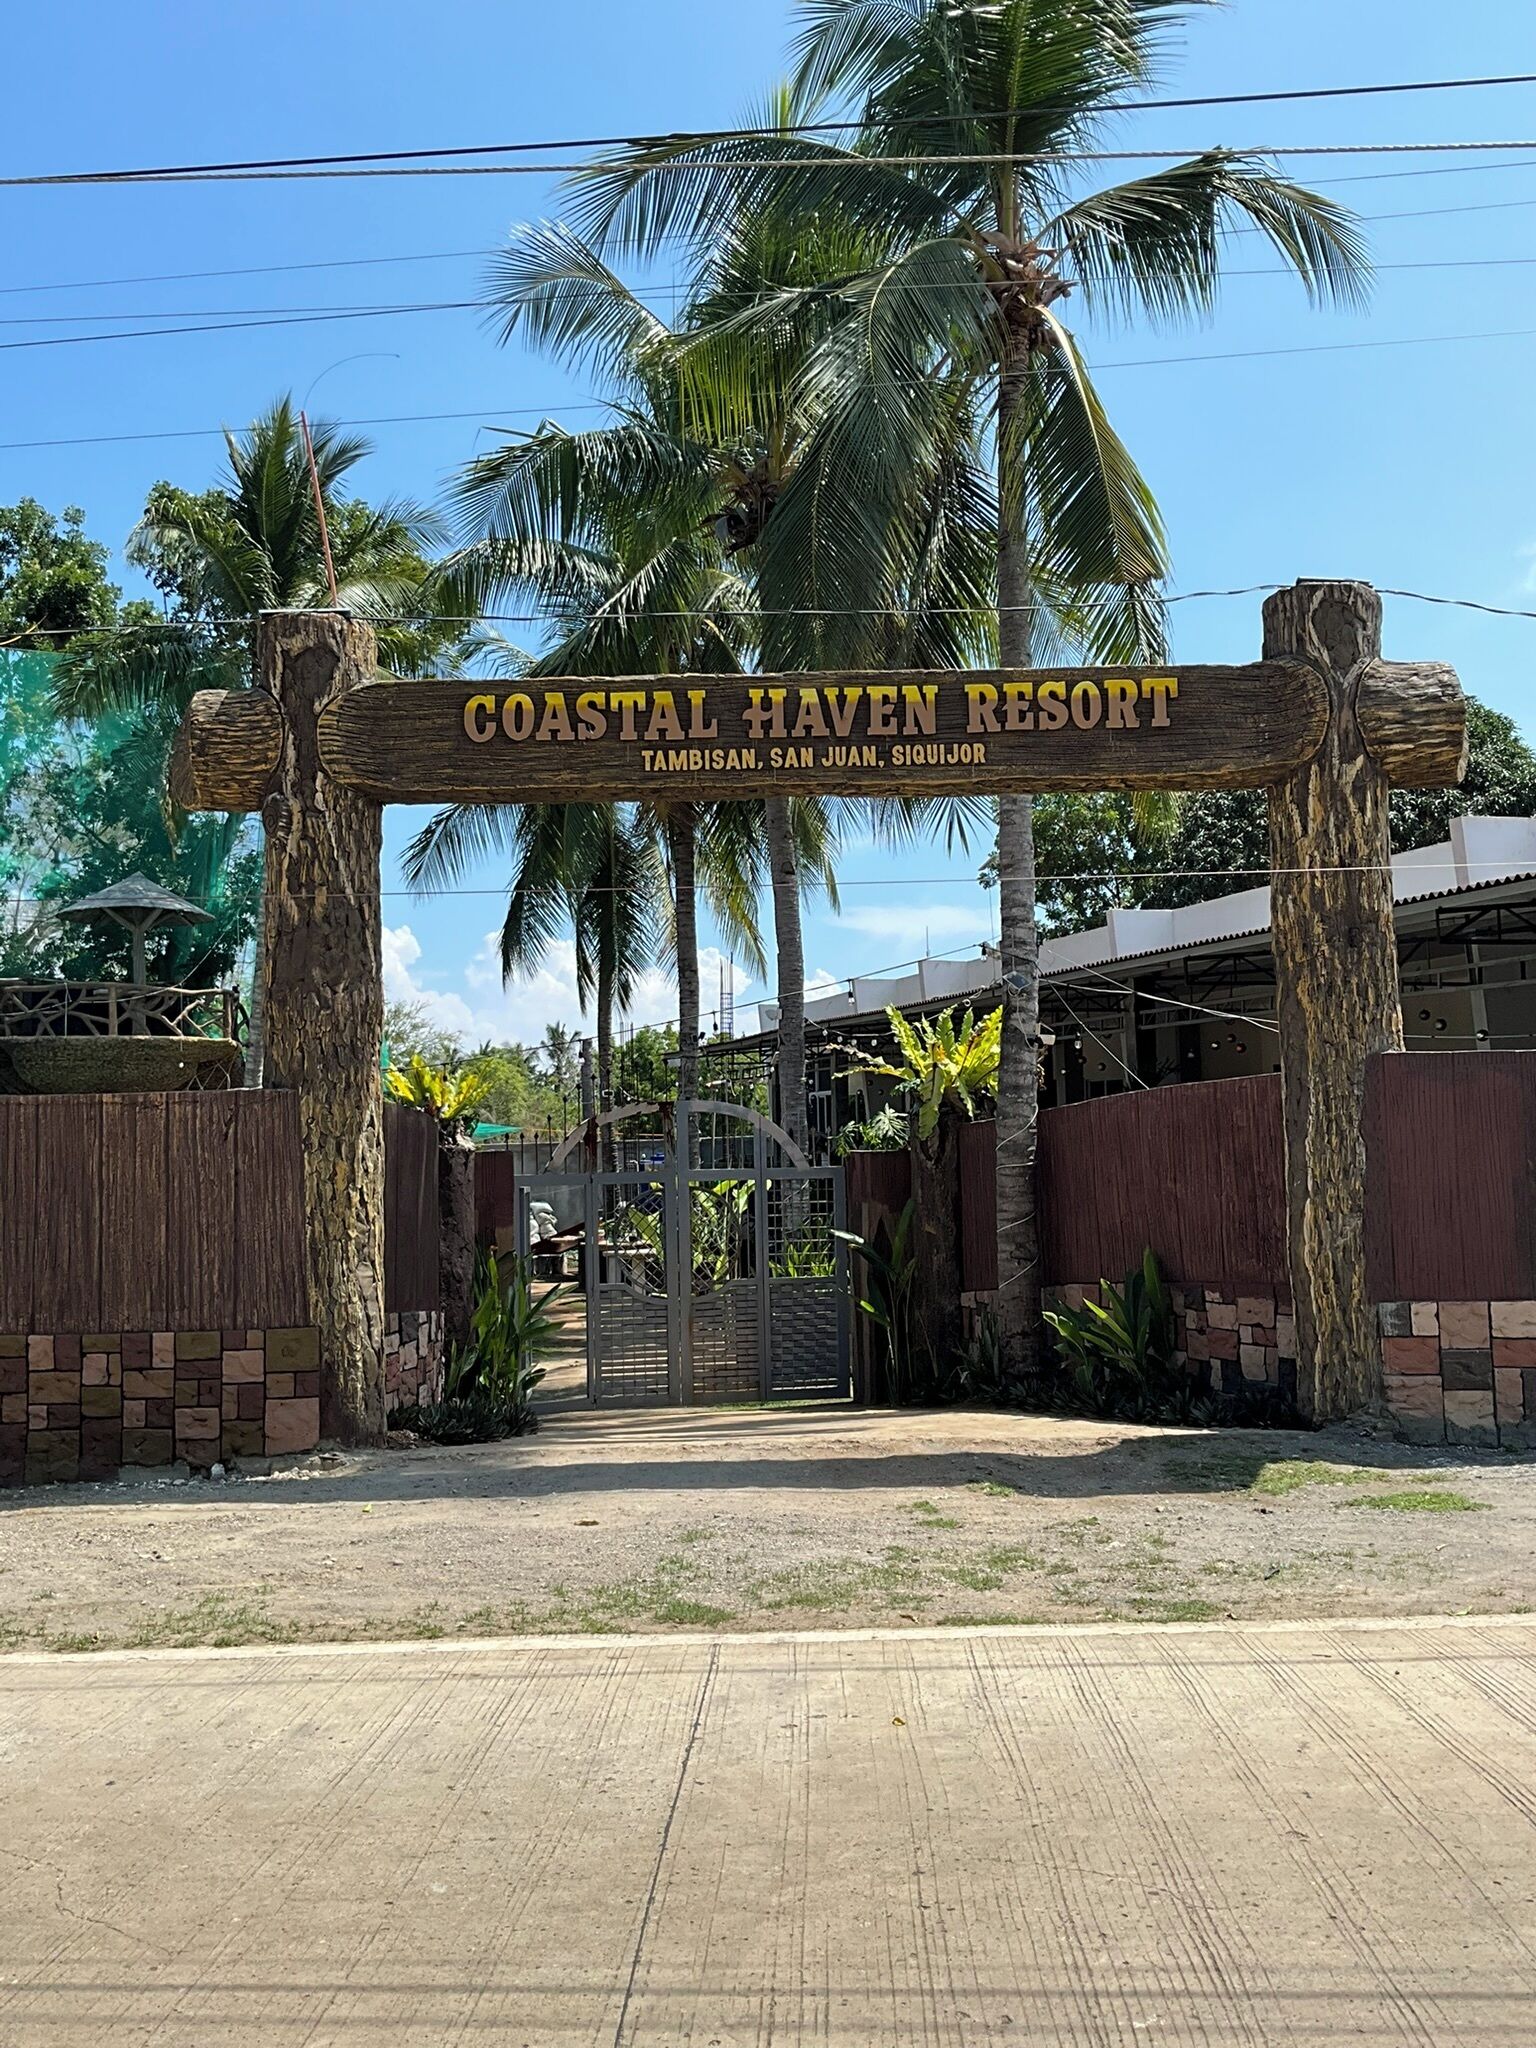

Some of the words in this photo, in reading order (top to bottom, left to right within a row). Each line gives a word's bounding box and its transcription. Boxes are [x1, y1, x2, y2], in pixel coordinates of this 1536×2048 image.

[464, 690, 718, 743] COASTAL
[742, 685, 938, 739] HAVEN
[965, 677, 1178, 733] RESORT
[642, 749, 764, 771] TAMBISAN,
[771, 747, 814, 768] SAN
[822, 746, 885, 769] JUAN,
[892, 743, 986, 766] SIQUIJOR
